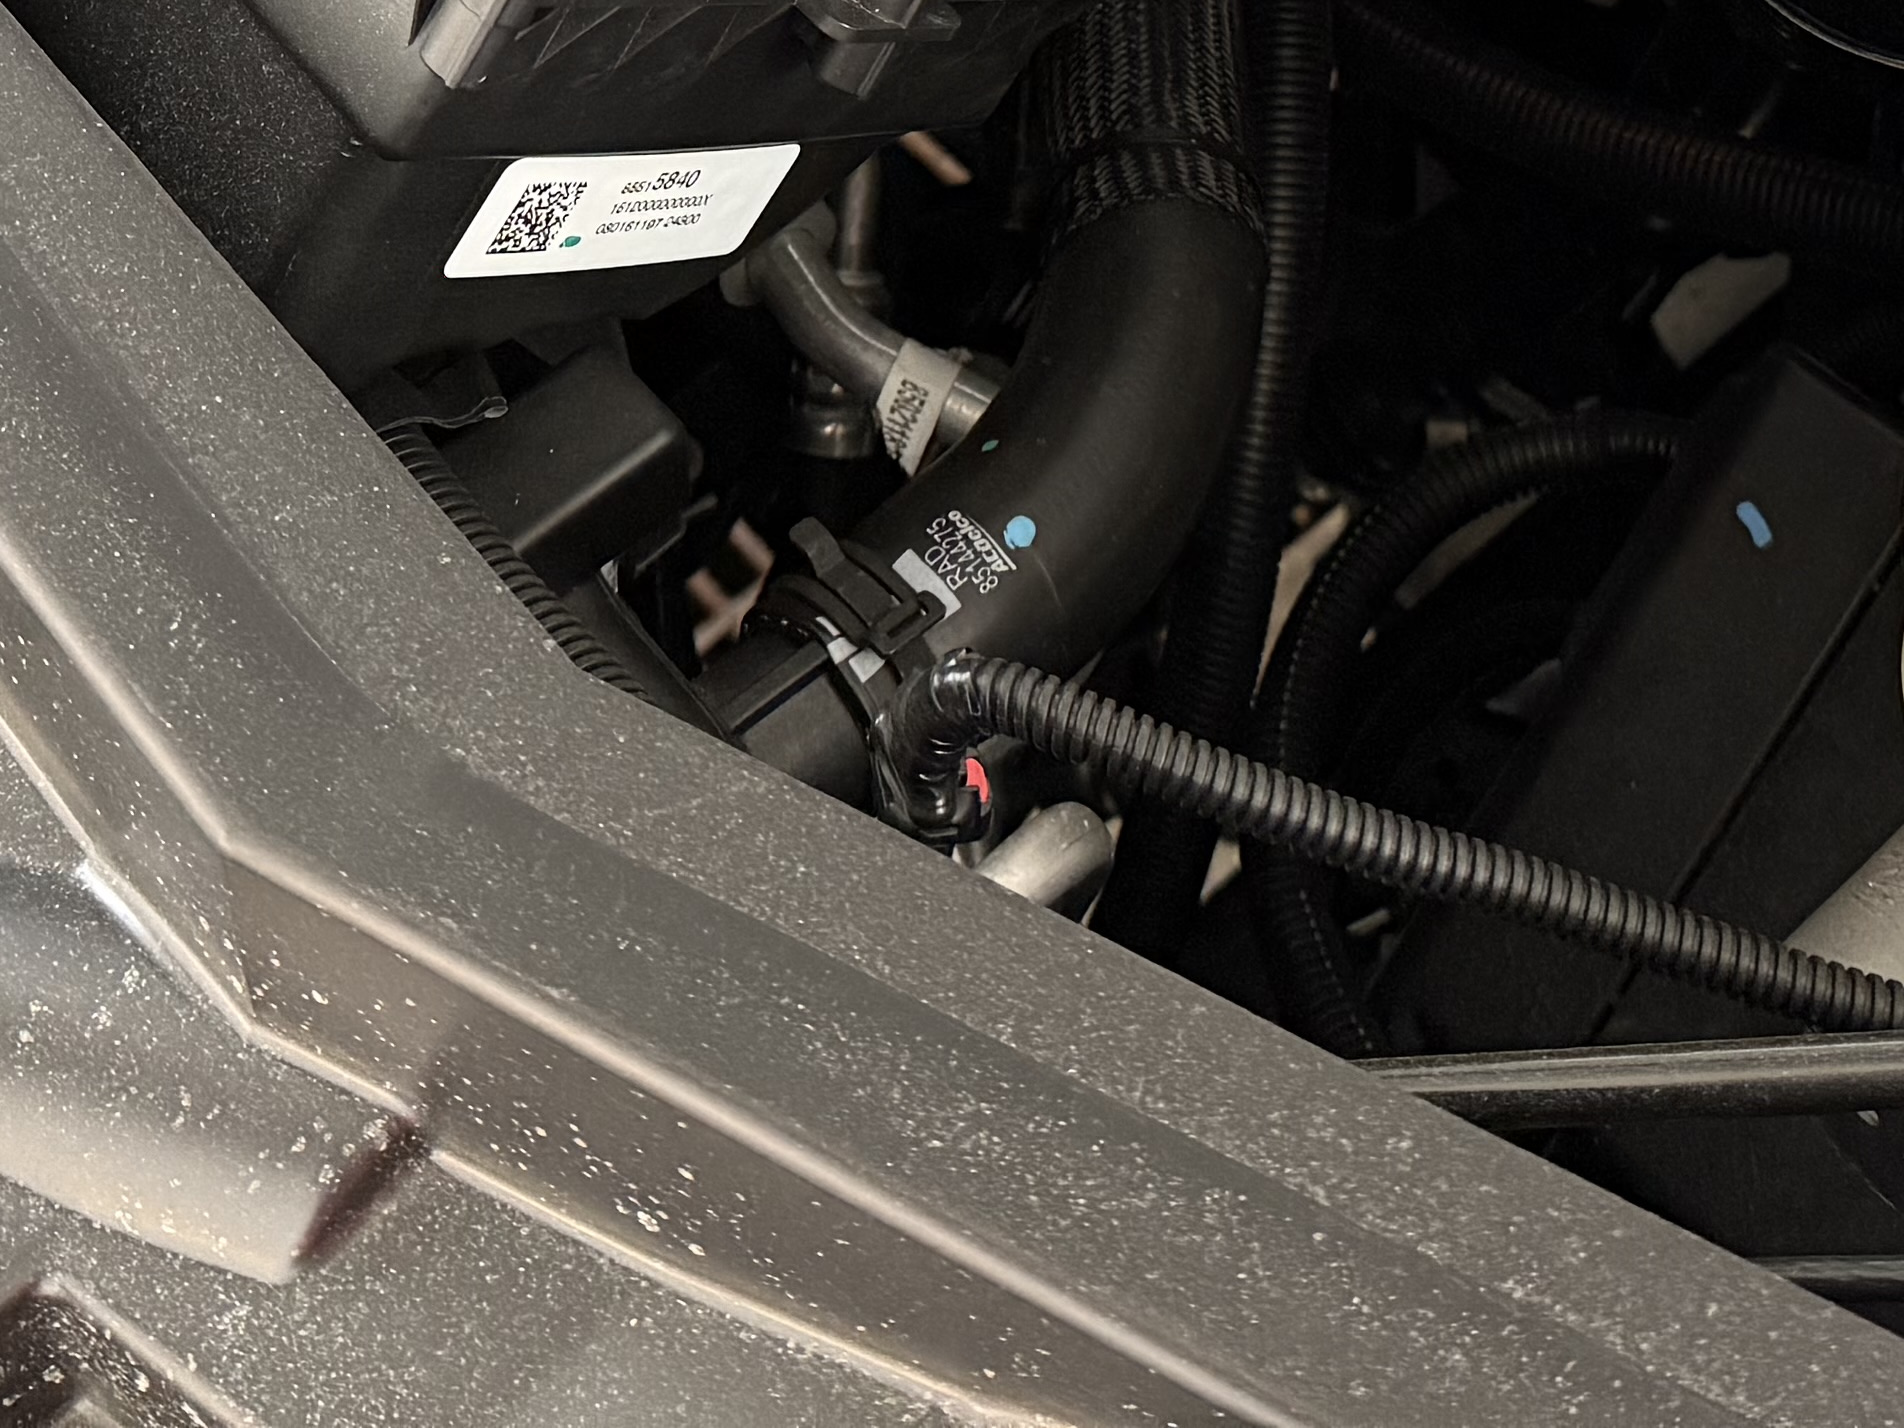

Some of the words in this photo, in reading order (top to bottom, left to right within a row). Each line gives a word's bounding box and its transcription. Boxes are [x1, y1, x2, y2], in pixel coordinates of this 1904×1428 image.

[924, 544, 969, 591] RAD
[925, 516, 999, 595] 85144275
[947, 509, 1011, 572] ACDelco
